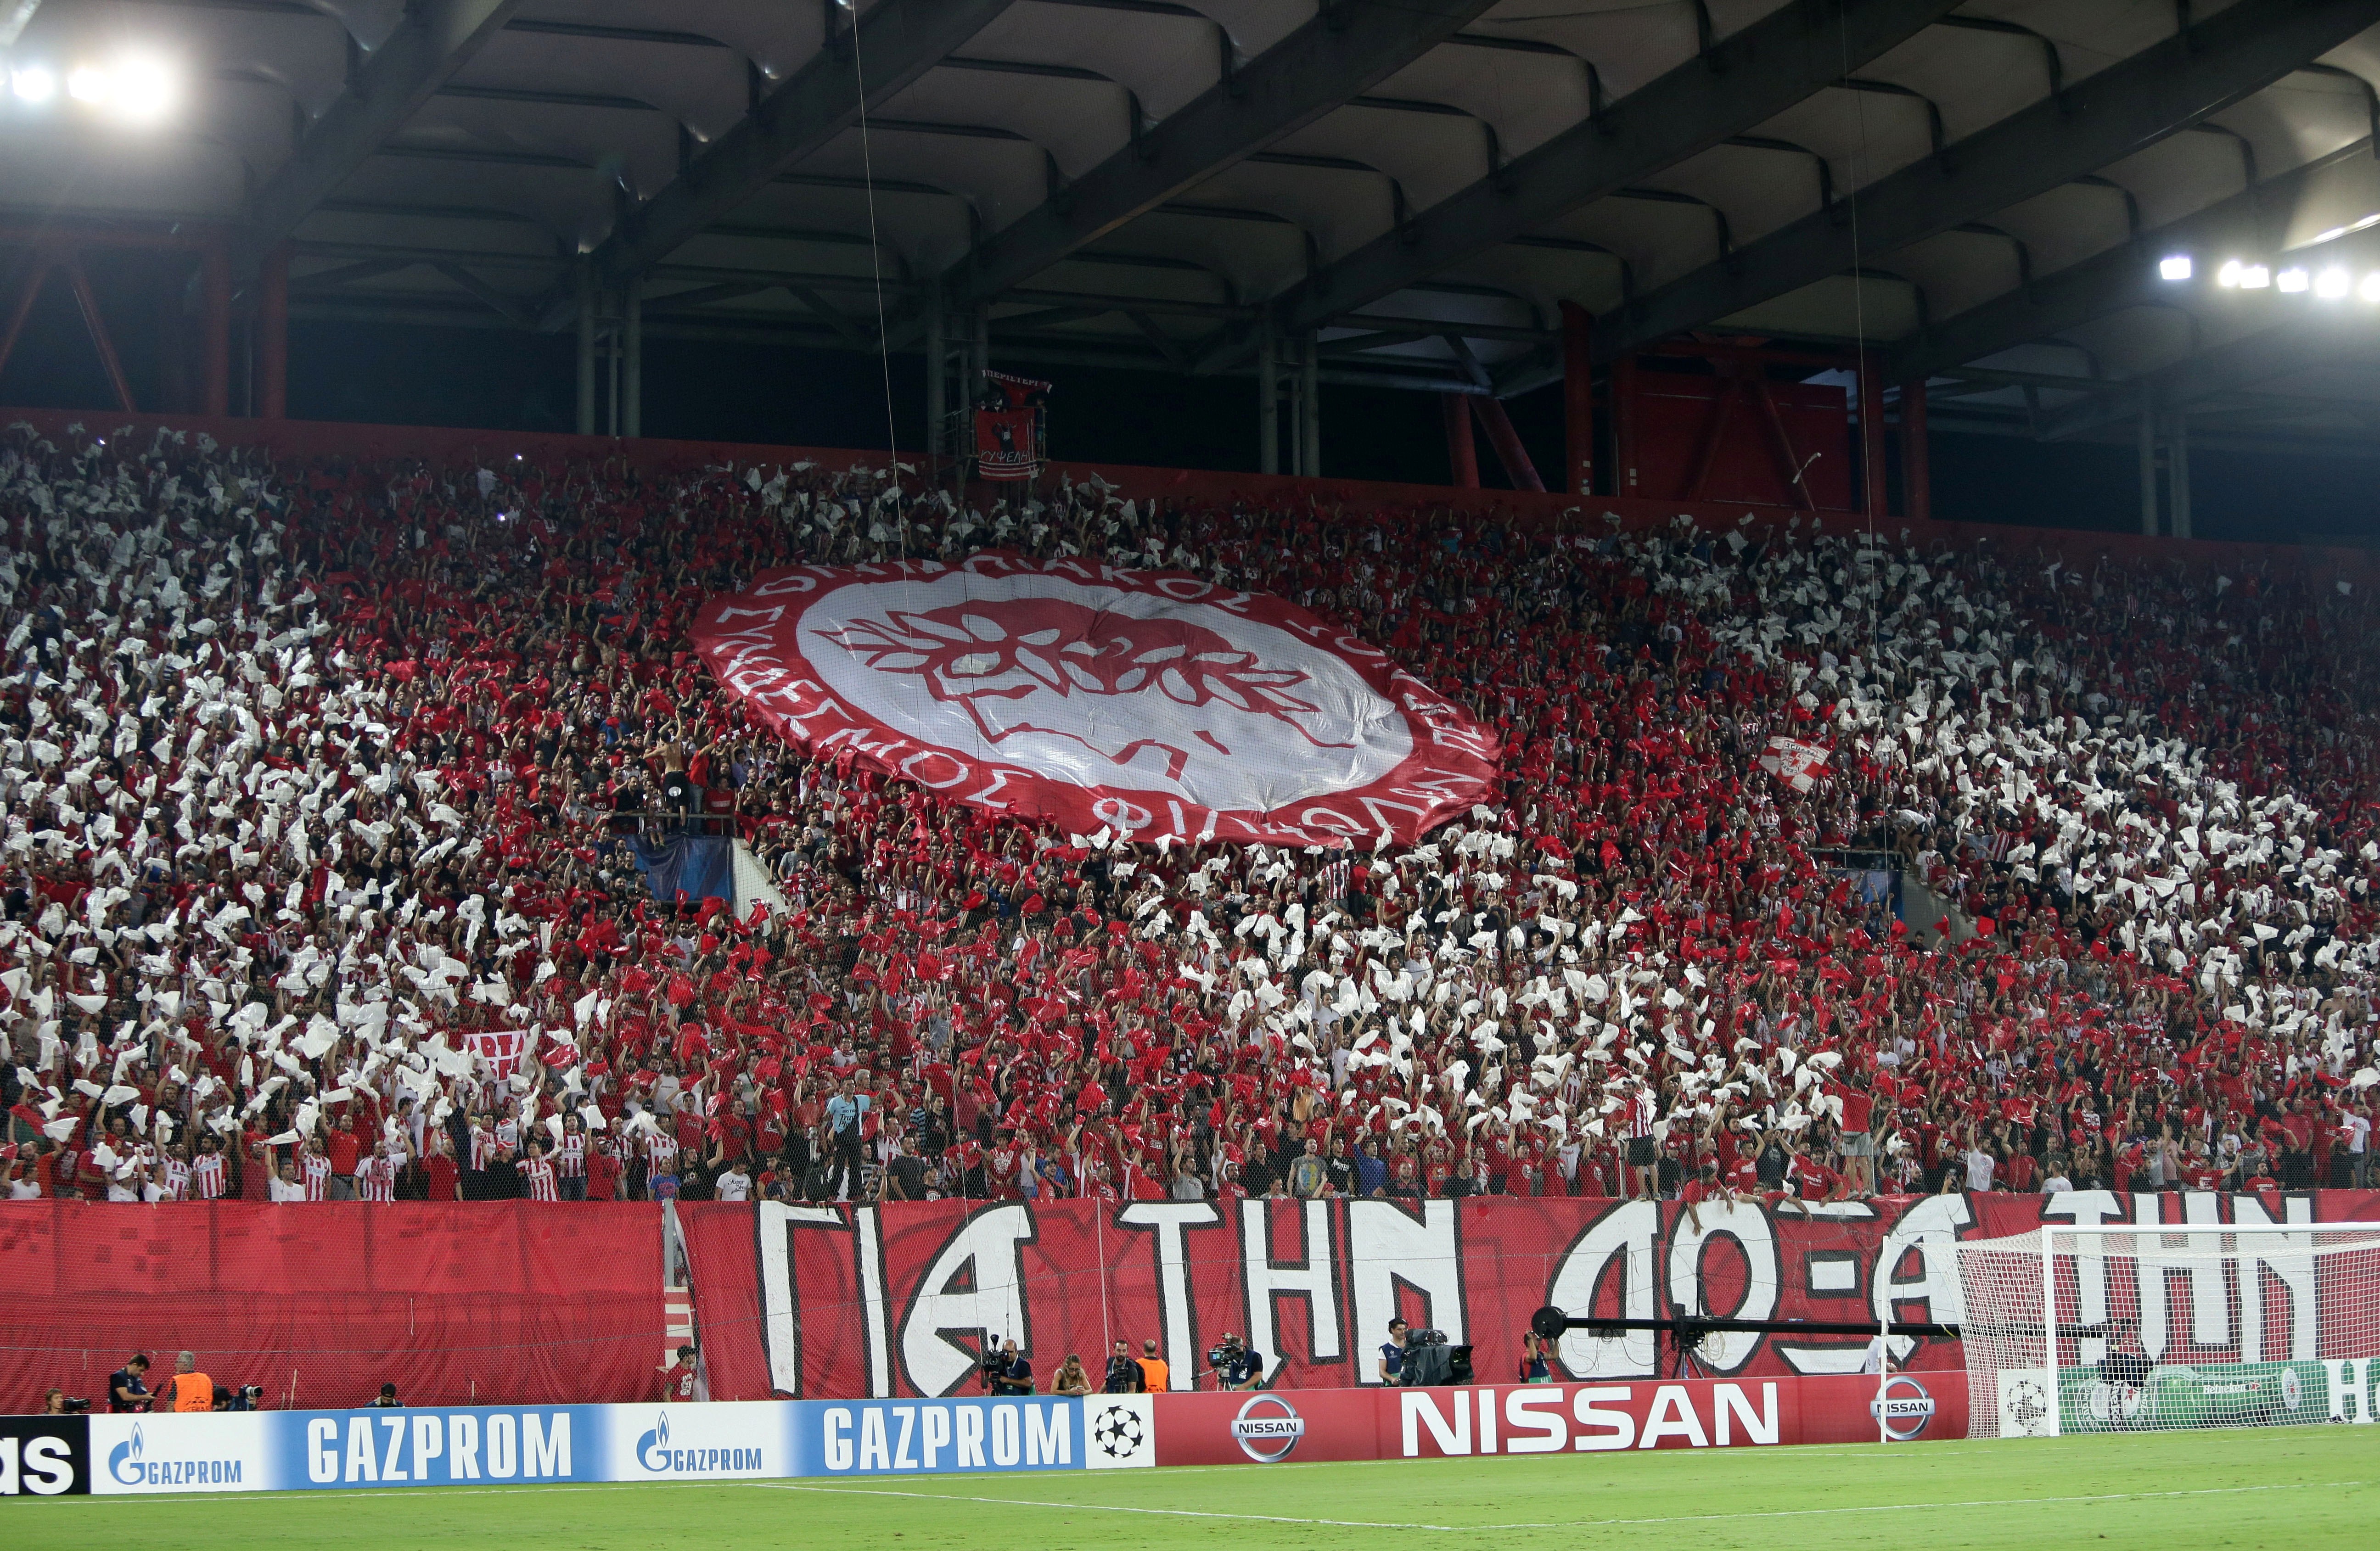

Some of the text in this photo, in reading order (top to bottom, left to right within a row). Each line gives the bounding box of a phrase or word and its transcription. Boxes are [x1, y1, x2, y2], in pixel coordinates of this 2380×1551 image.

[753, 1191, 2320, 1399] ΓΙΑ ΤΗΝ ΔΟΞΑ ΤΗΝ
[2203, 1383, 2246, 1394] Heineken
[823, 1402, 1072, 1470] GAZPROM
[1239, 1422, 1297, 1433] NISSAN
[1401, 1382, 1779, 1456] NISSAN
[307, 1412, 572, 1483] GAZPROM
[674, 1447, 761, 1471] GAZPROM
[148, 1460, 242, 1484] GAZPROM
